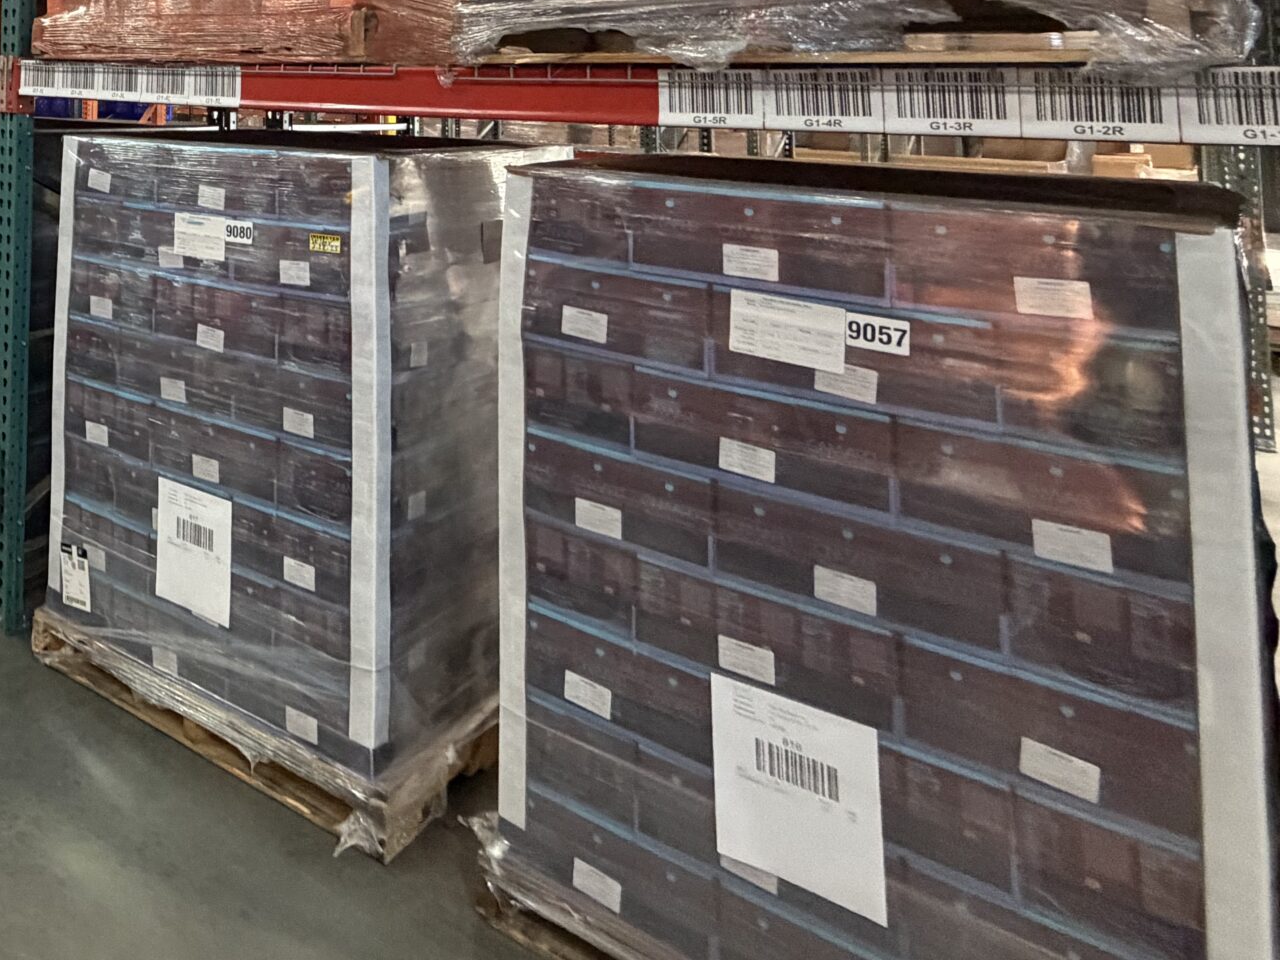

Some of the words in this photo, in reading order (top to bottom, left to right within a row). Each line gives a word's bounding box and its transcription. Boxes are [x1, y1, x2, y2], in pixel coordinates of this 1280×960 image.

[693, 115, 728, 126] G1-5R
[803, 118, 843, 129] G1-4R
[929, 120, 974, 132] G1-3R
[1073, 124, 1125, 137] G1-2R
[1242, 128, 1280, 141] G1-
[225, 224, 252, 240] 9080
[847, 320, 908, 348] 9057
